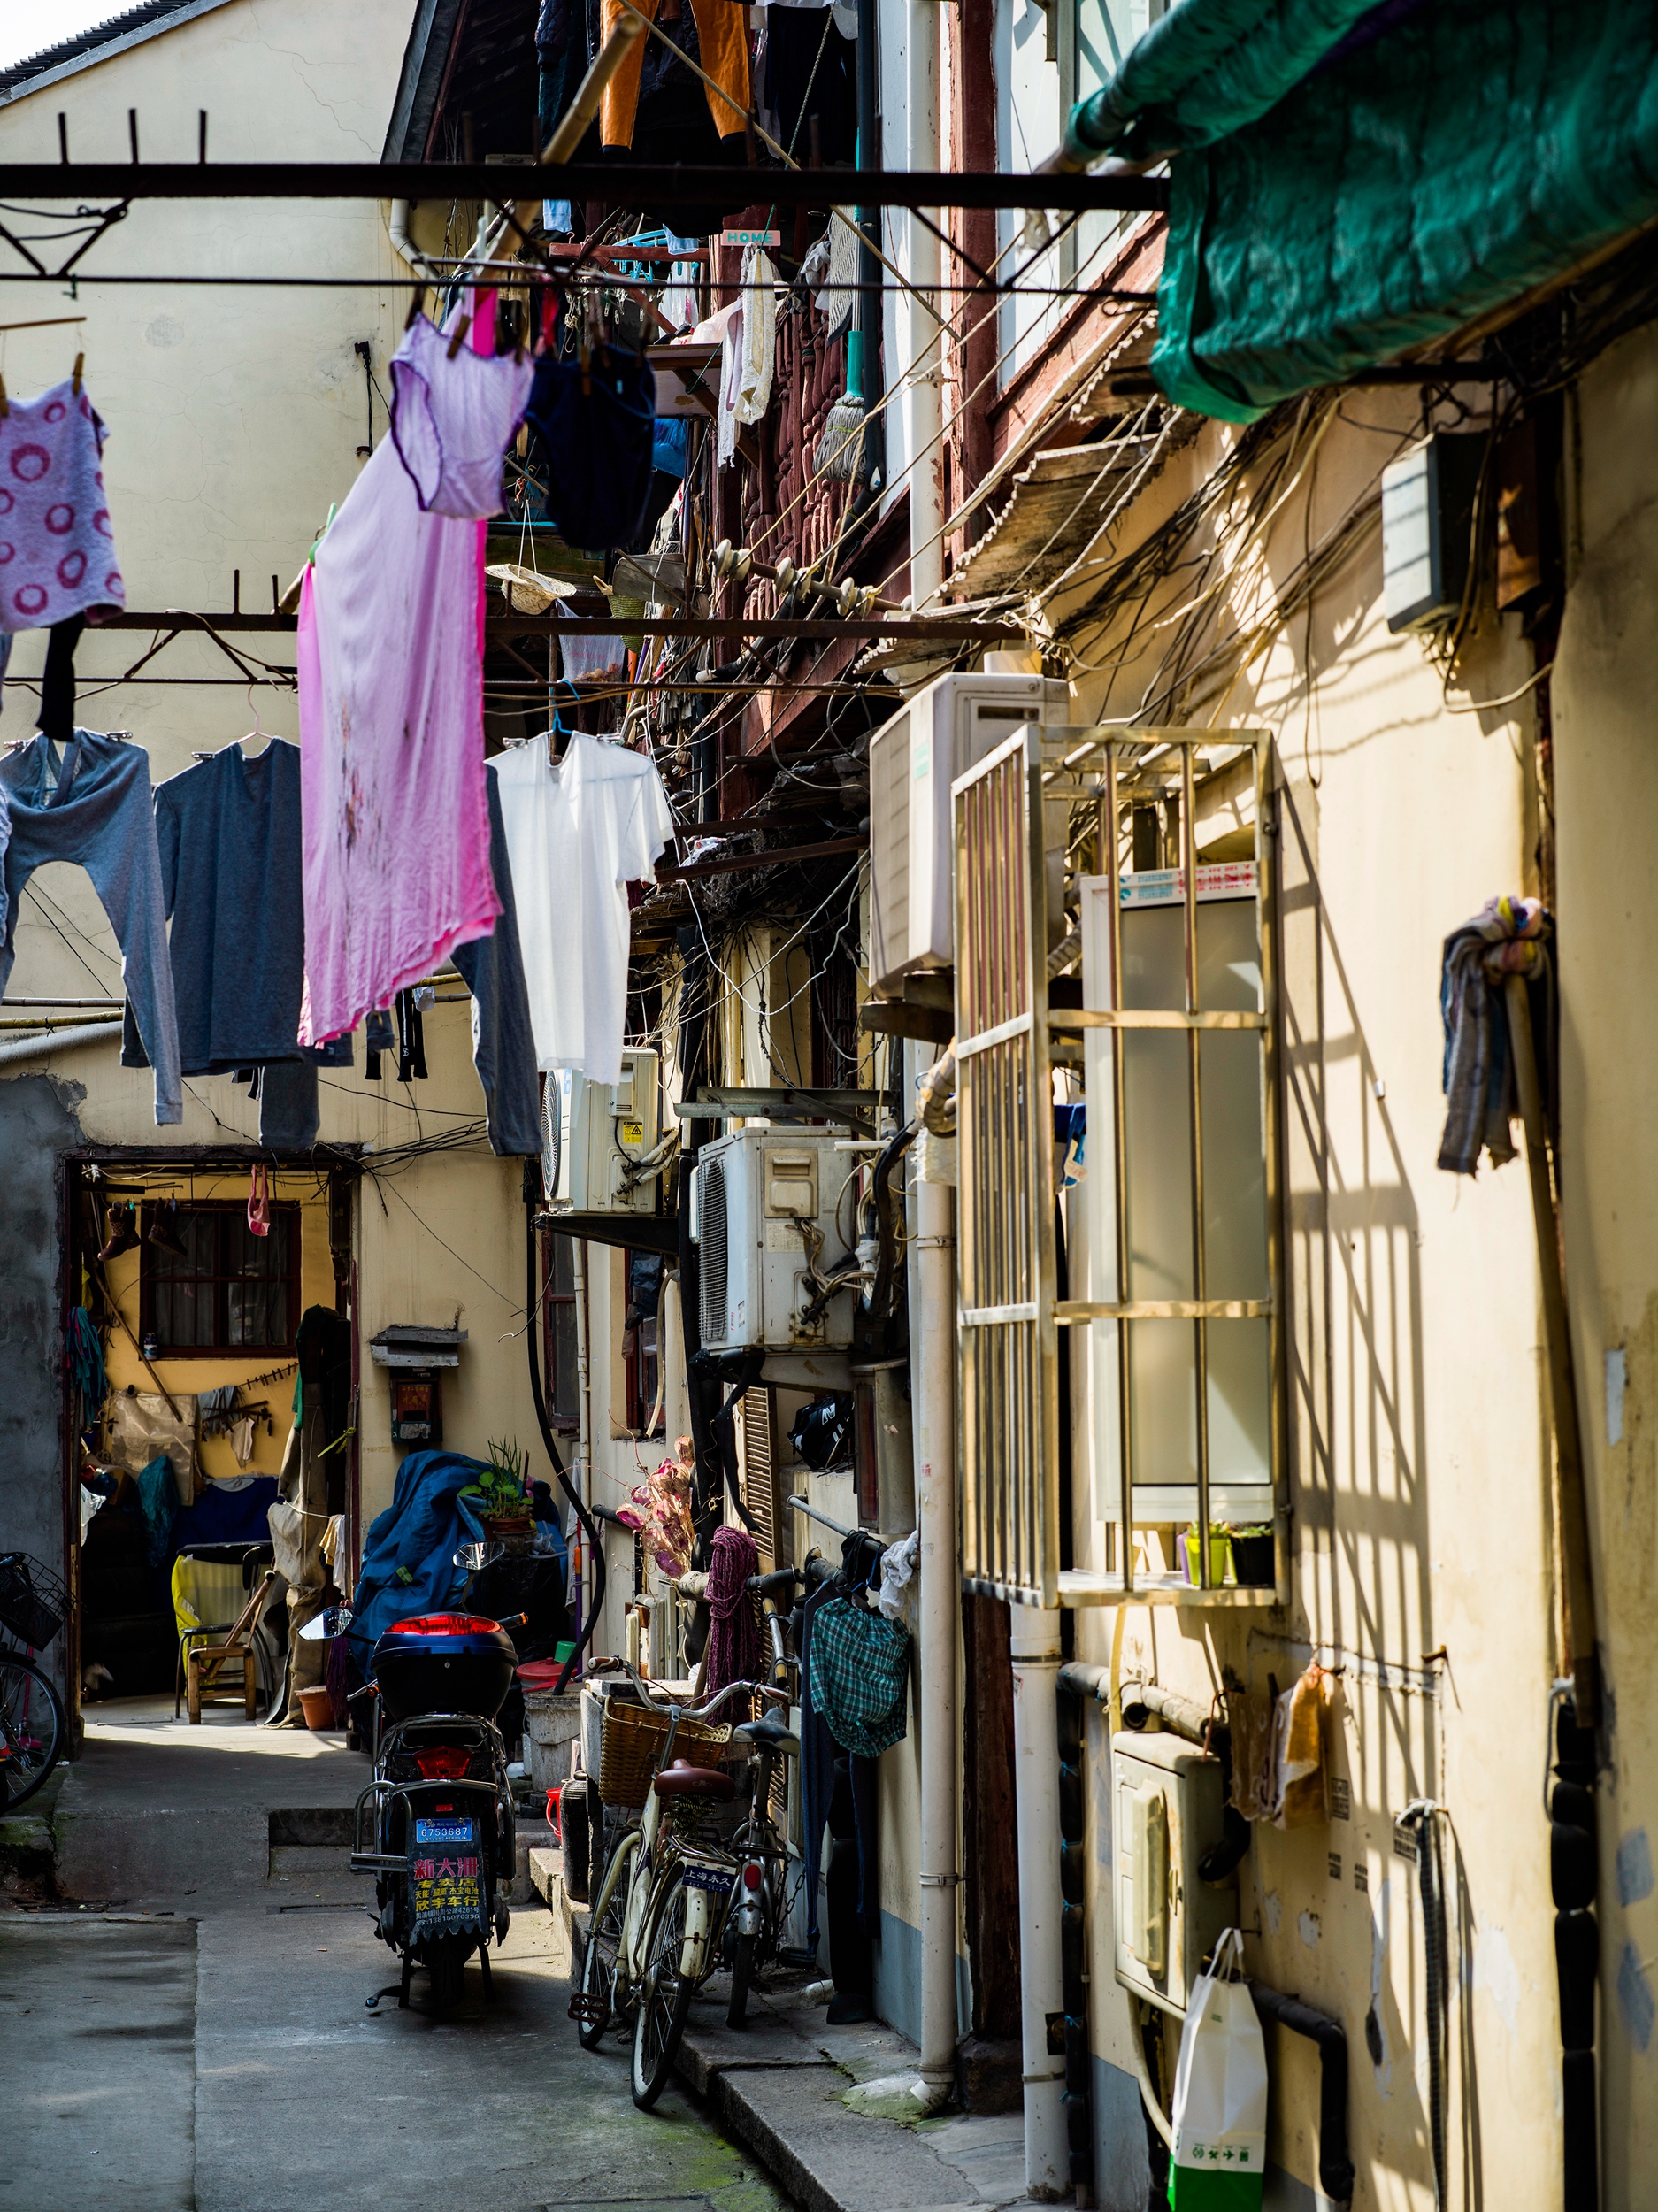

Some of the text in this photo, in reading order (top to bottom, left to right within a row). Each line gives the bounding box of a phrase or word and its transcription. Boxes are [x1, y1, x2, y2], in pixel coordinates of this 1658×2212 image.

[727, 233, 773, 243] HOME
[421, 1827, 467, 1837] 6753687
[413, 1857, 479, 1880] 新大洲
[418, 1878, 476, 1888] 专卖店
[685, 1870, 731, 1886] 上海永久
[415, 1889, 429, 1899] 天能
[415, 1896, 479, 1912] 欣宇车行
